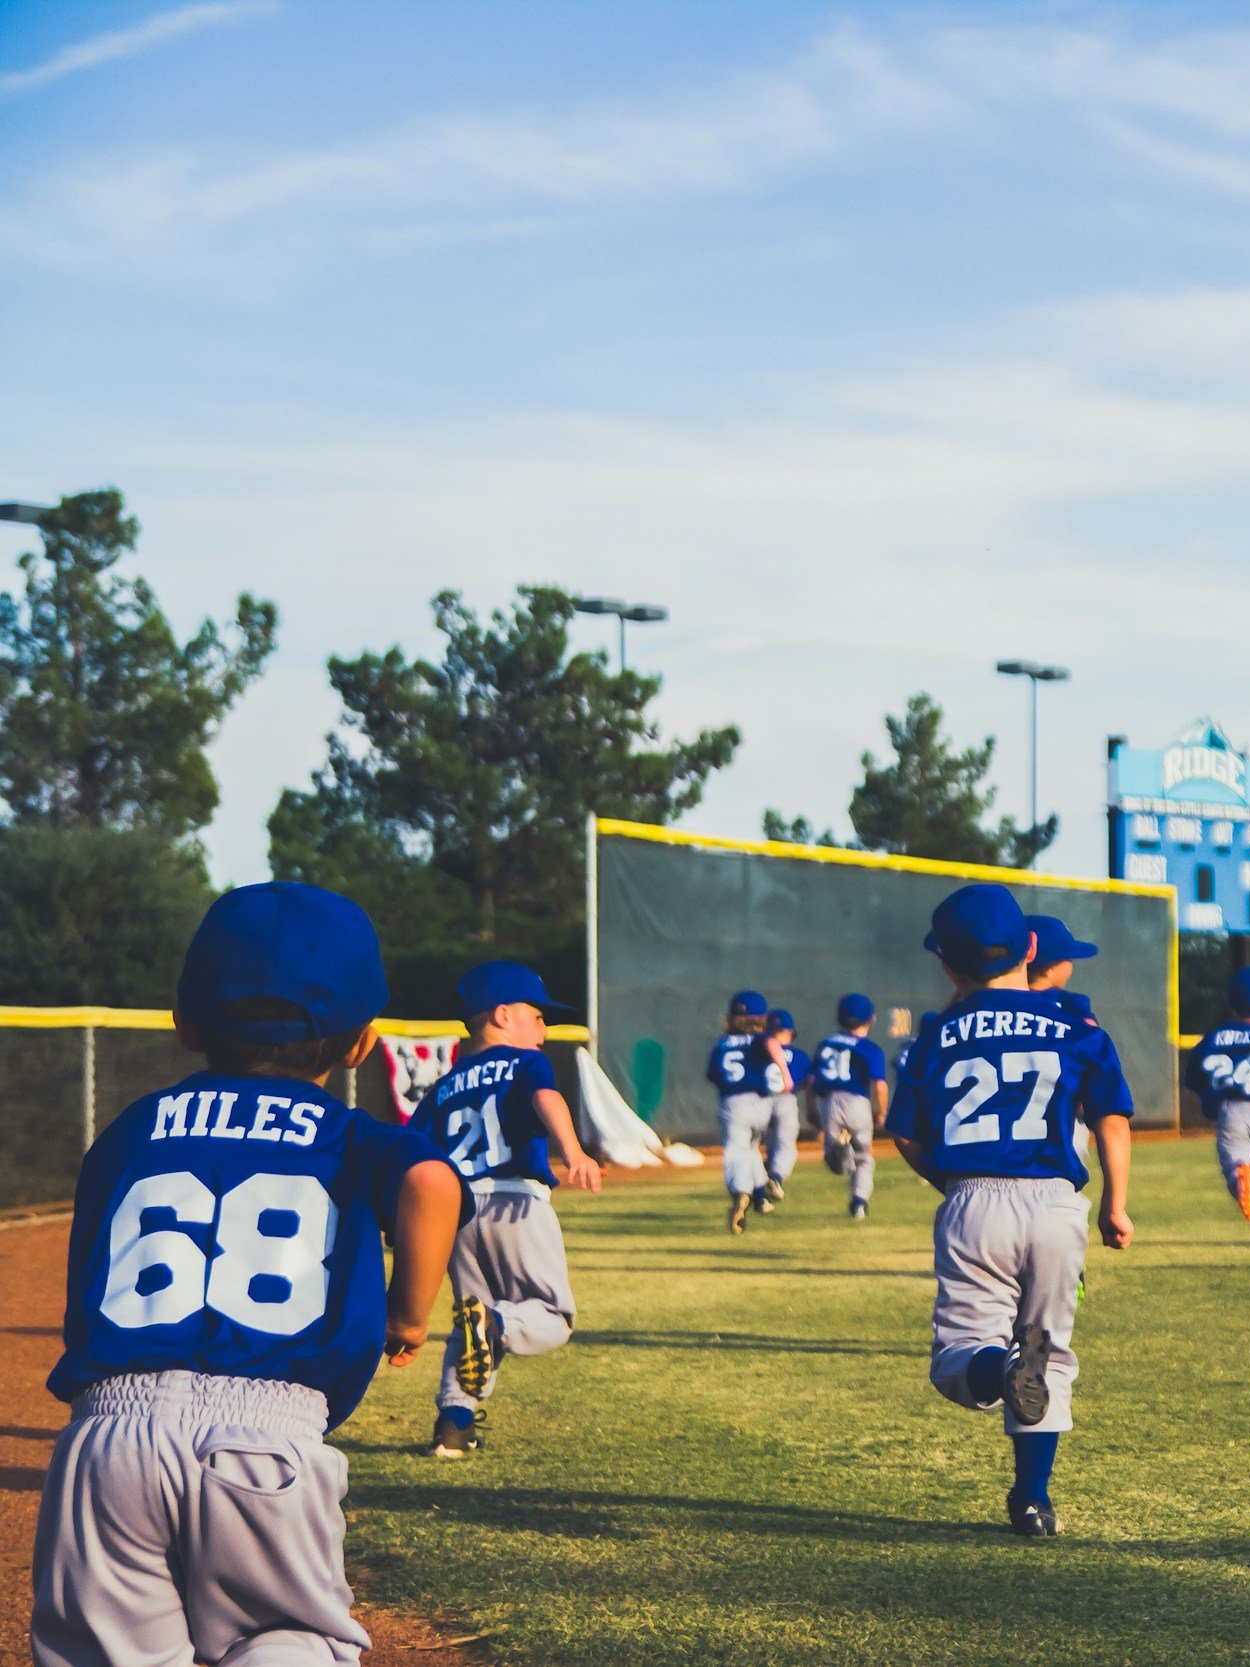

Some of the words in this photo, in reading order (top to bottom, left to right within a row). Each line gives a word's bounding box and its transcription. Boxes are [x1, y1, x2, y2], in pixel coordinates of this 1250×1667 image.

[1163, 745, 1247, 797] RIDGE
[1132, 815, 1160, 840] BALL
[1127, 854, 1168, 882] GUEST
[941, 1011, 1071, 1048] EVERETT
[437, 1058, 519, 1106] BENNETT
[821, 1047, 851, 1081] 31
[150, 1090, 325, 1146] MILES
[944, 1051, 1062, 1147] 27
[447, 1094, 512, 1177] 21
[99, 1171, 339, 1336] 68
